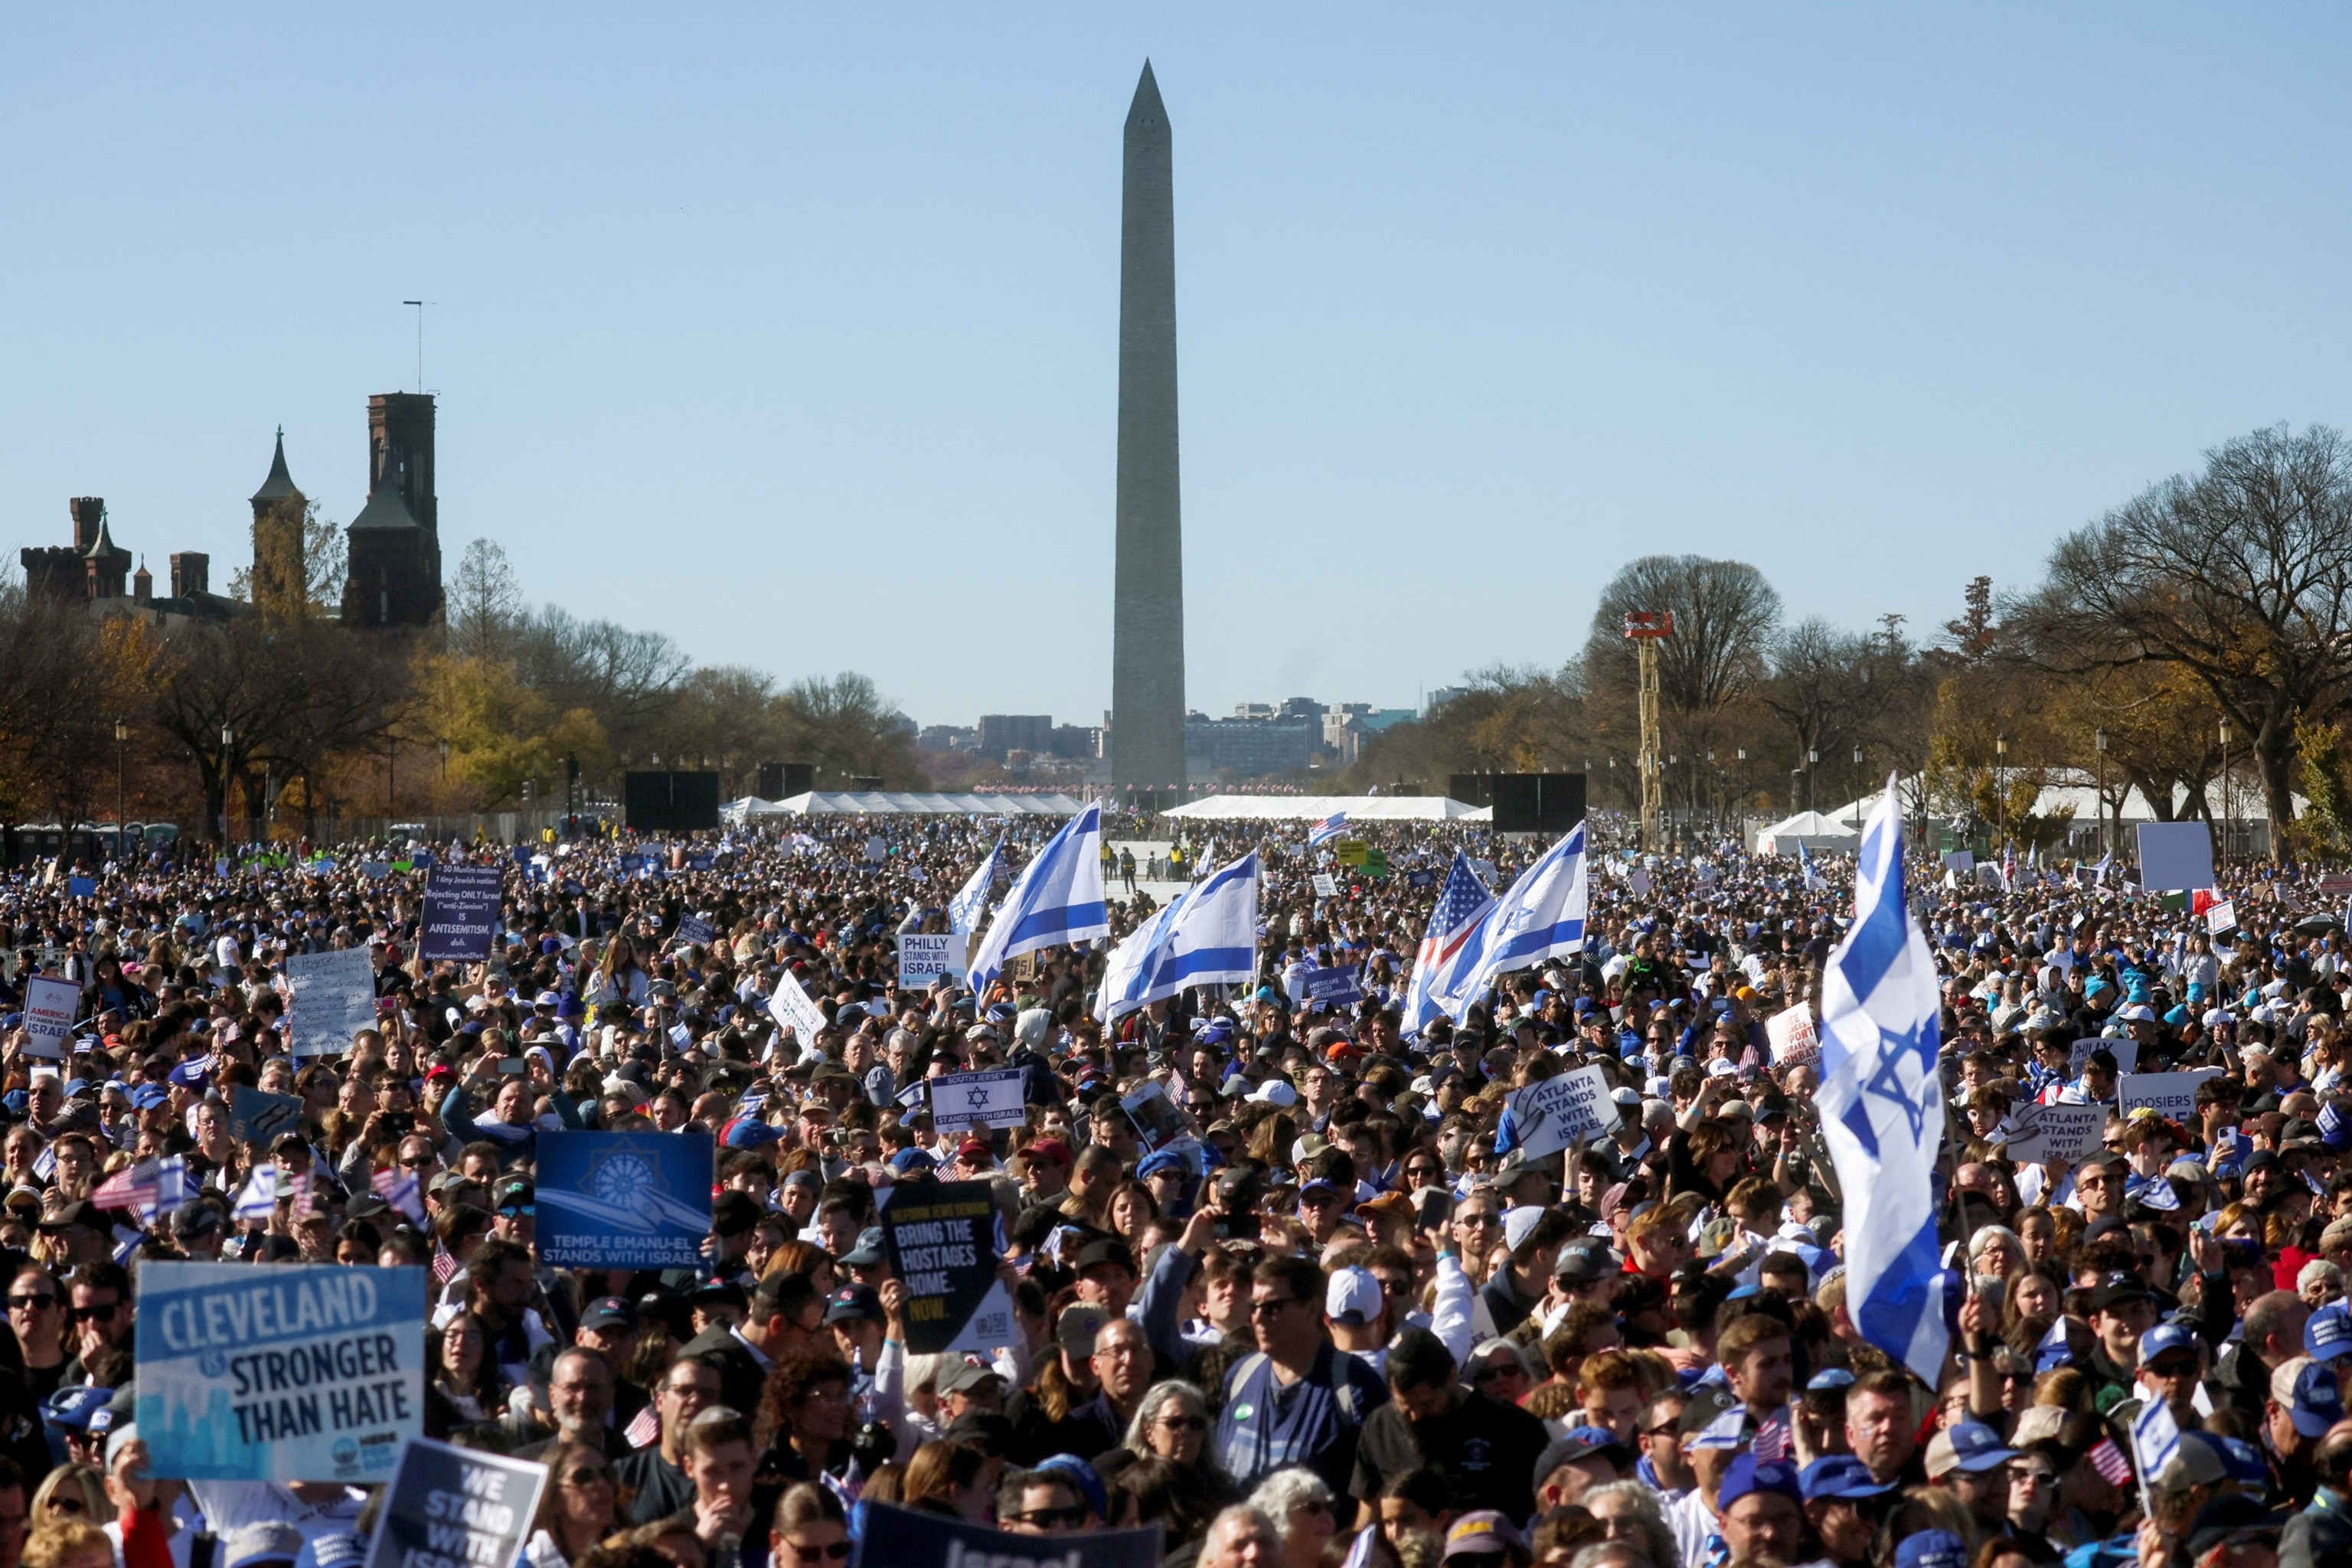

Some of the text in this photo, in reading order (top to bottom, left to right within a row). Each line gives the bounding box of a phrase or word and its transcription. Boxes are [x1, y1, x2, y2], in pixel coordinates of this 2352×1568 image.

[440, 876, 453, 885] tiny
[426, 889, 502, 900] Rejecting ONLY Israel
[458, 913, 466, 921] IS
[429, 924, 490, 935] ANTISEMITISM,
[689, 923, 705, 934] STAND
[450, 938, 466, 946] duh.
[904, 938, 949, 949] PHILLY
[904, 951, 949, 962] STANDS WITH
[289, 960, 298, 969] A
[325, 978, 368, 988] School
[1309, 978, 1339, 989] AMERICANS
[1311, 985, 1332, 995] AGAINST
[28, 1016, 54, 1025] STANDS
[30, 1007, 70, 1021] AMERICA
[1783, 1046, 1817, 1066] OMBAT
[947, 1072, 1006, 1085] SOUTH JERSEY
[1537, 1075, 1596, 1102] ATLANTA
[1545, 1089, 1597, 1114] STANDS
[2125, 1095, 2191, 1109] HOOSIERS
[938, 1109, 1021, 1125] STANDS WITH ISRAEL
[1557, 1104, 1595, 1124] WITH
[2039, 1112, 2098, 1124] ATLANTA
[1557, 1117, 1605, 1140] ISRAEL
[2041, 1125, 2092, 1135] STANDS
[2050, 1138, 2083, 1148] WITH
[894, 1220, 975, 1247] BRING THE
[553, 1235, 693, 1250] TEMPLE EMANU-EL
[543, 1249, 701, 1264] STANDS WITH ISRAEL
[899, 1244, 977, 1271] HOSTAGES
[905, 1271, 956, 1296] HOME.
[162, 1272, 378, 1351] CLEVELAND
[908, 1296, 951, 1321] NOW.
[230, 1334, 400, 1397] STRONGER
[233, 1379, 412, 1445] THAN HATE
[461, 1463, 508, 1501] WE
[423, 1488, 515, 1536] STAND
[427, 1521, 501, 1565] WITH
